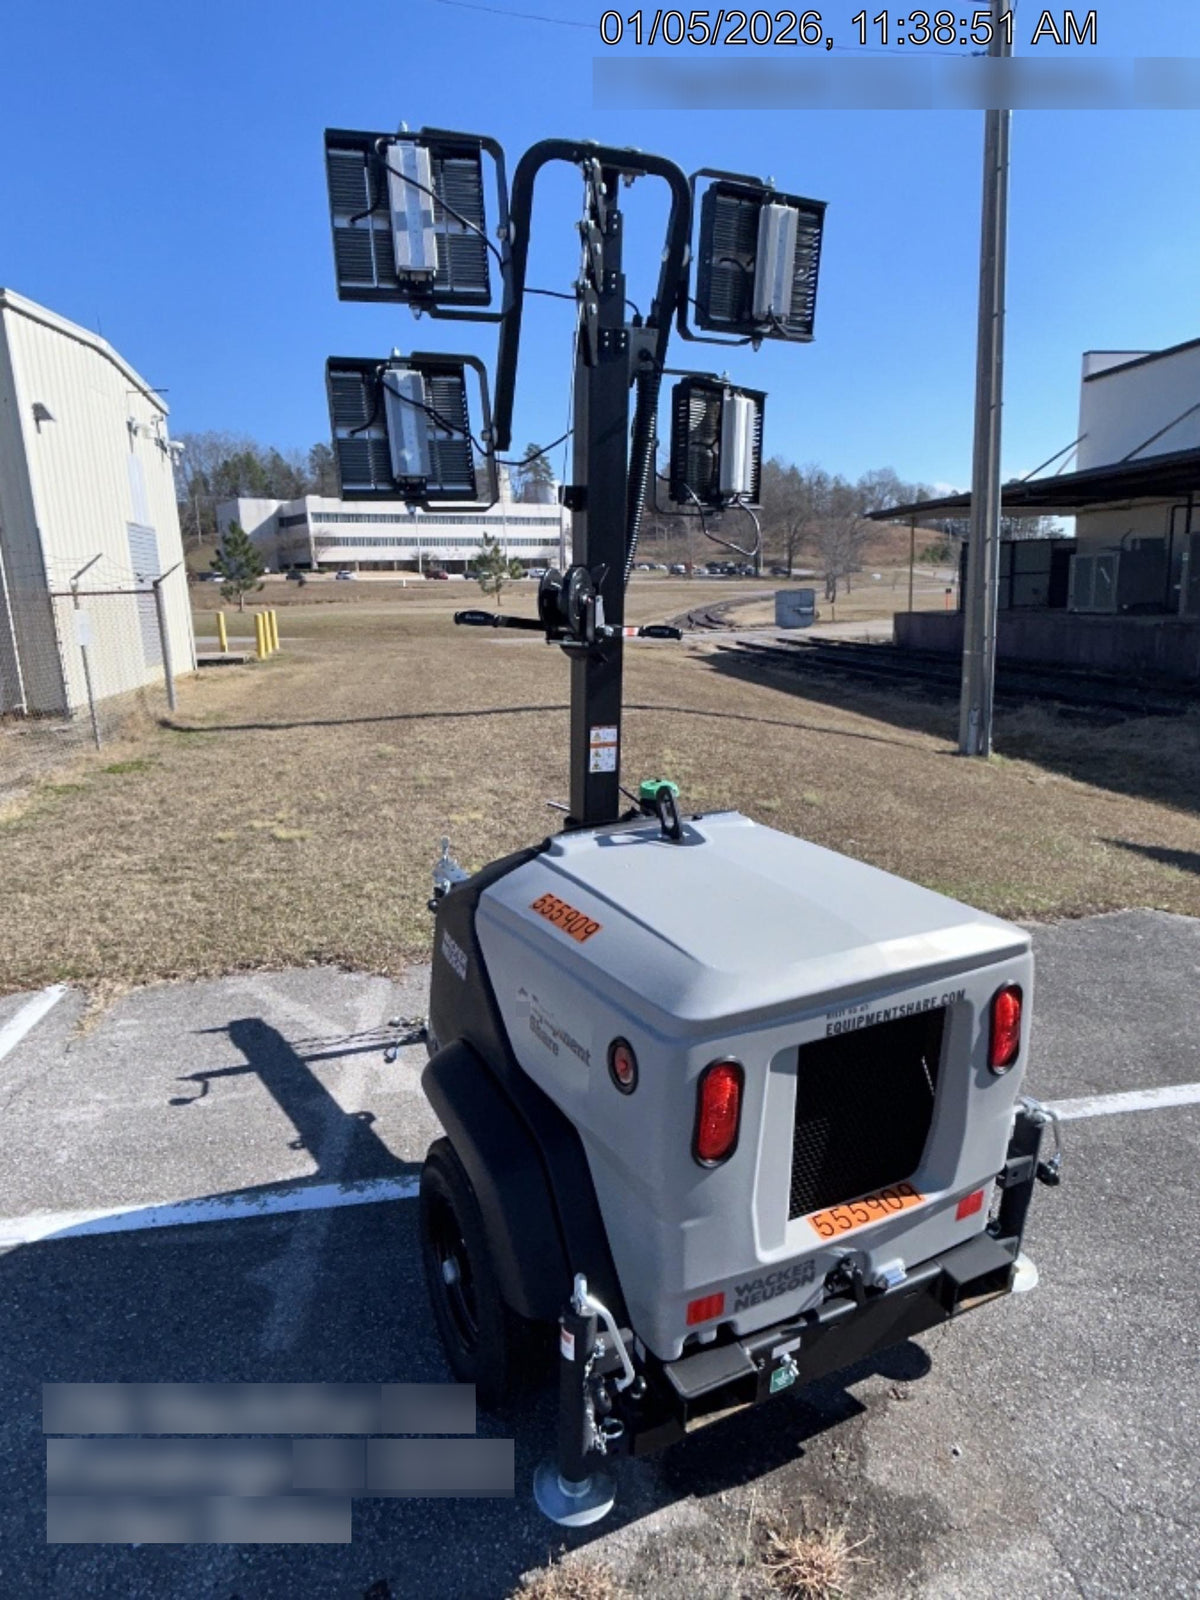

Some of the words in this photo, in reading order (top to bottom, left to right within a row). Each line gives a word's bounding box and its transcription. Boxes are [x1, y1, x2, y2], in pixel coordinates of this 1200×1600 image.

[532, 894, 600, 942] 555909
[826, 989, 966, 1036] EQUIPMENTSHARE.COM
[812, 1182, 922, 1237] 555909
[734, 1259, 816, 1297] WACKER
[734, 1272, 816, 1312] NEUSON
